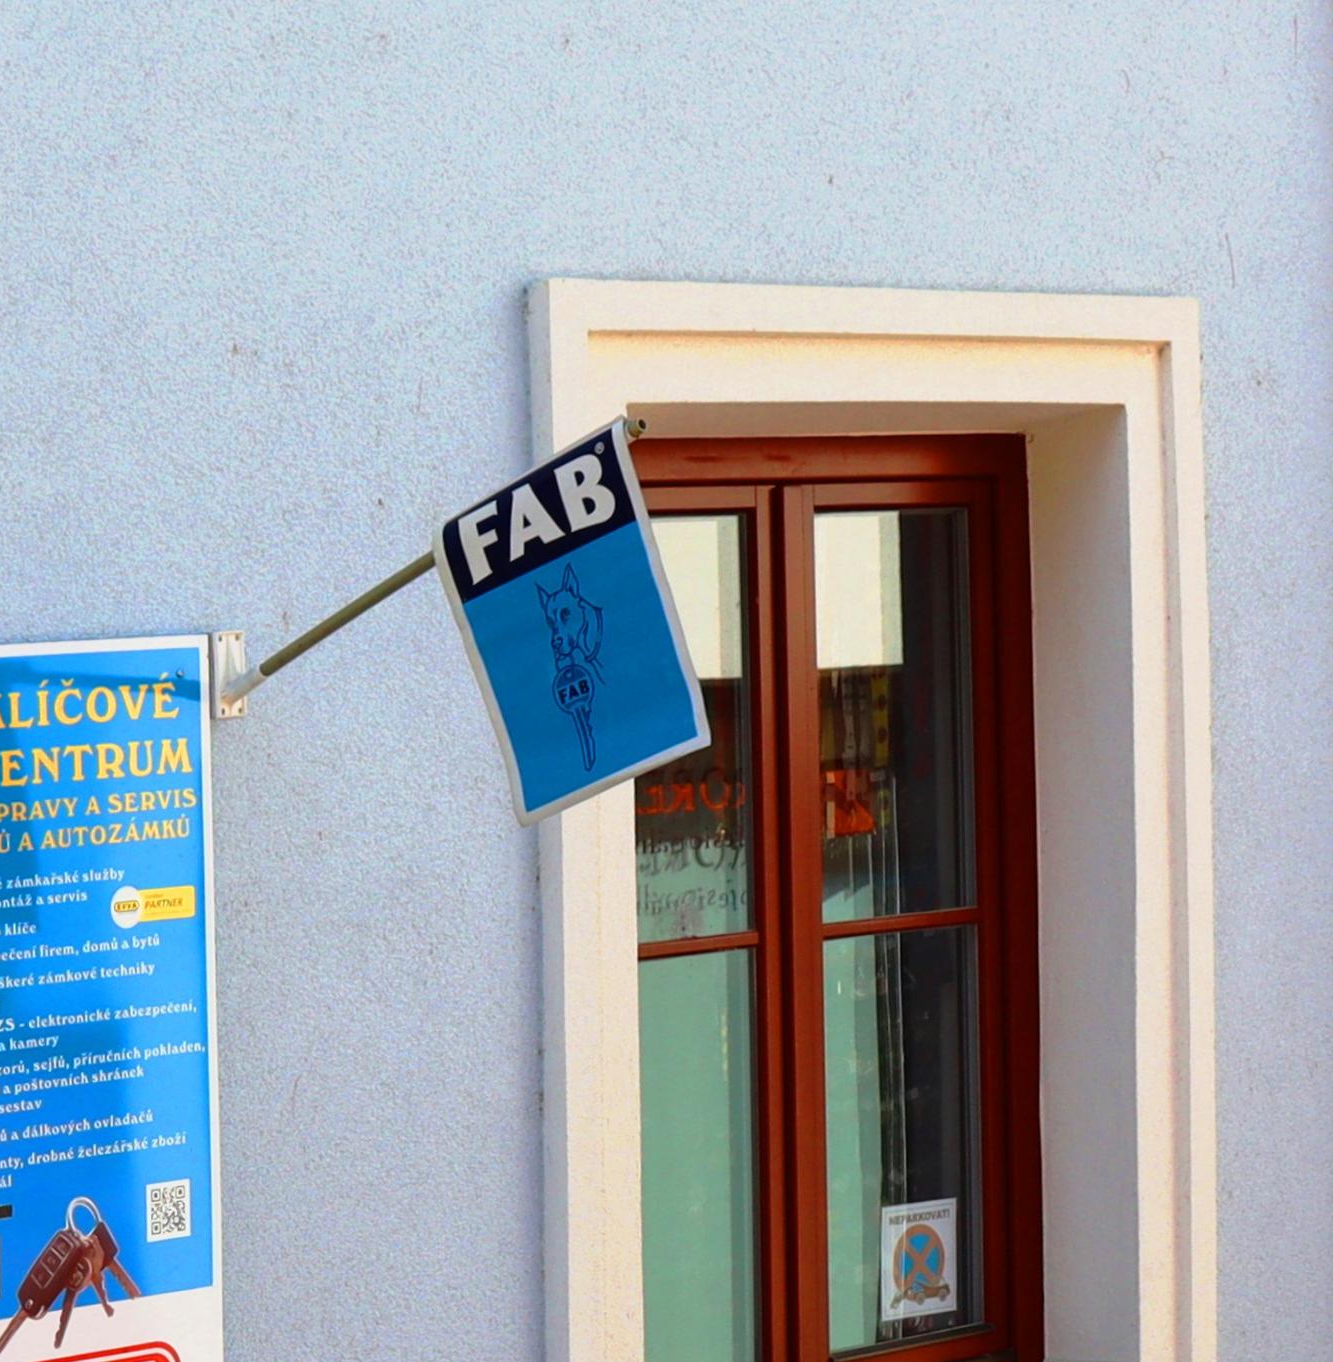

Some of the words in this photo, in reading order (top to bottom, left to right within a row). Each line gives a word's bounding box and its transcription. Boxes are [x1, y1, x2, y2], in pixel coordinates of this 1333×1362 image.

[458, 453, 616, 585] FAB
[558, 679, 590, 704] FAB
[86, 799, 99, 815] A
[108, 788, 196, 813] SERVIS
[18, 832, 33, 850] A
[41, 813, 190, 849] AUTOZÁMKŮ
[7, 870, 79, 889] zámkařské
[83, 869, 124, 882] služby
[36, 896, 44, 905] a
[47, 890, 87, 903] servis
[145, 898, 183, 909] PARTNER
[5, 923, 37, 936] klíče
[40, 945, 79, 956] firem,
[83, 938, 117, 952] domů
[121, 940, 129, 948] a
[133, 934, 160, 948] bytů
[38, 968, 97, 985] zámkové
[101, 962, 155, 978] techniky
[29, 1009, 110, 1029] elektronické
[114, 1000, 197, 1018] zabezpečení,
[9, 1035, 59, 1052] kamery
[73, 1048, 141, 1069] příručních
[144, 1041, 205, 1060] pokladen,
[3, 1085, 11, 1094] a
[15, 1073, 89, 1094] poštovních
[11, 1131, 19, 1140] a
[23, 1120, 90, 1139] dálkových
[94, 1110, 153, 1128] ovladačů
[28, 1148, 74, 1165] drobné
[77, 1138, 148, 1158] železářské
[152, 1132, 186, 1148] zboží
